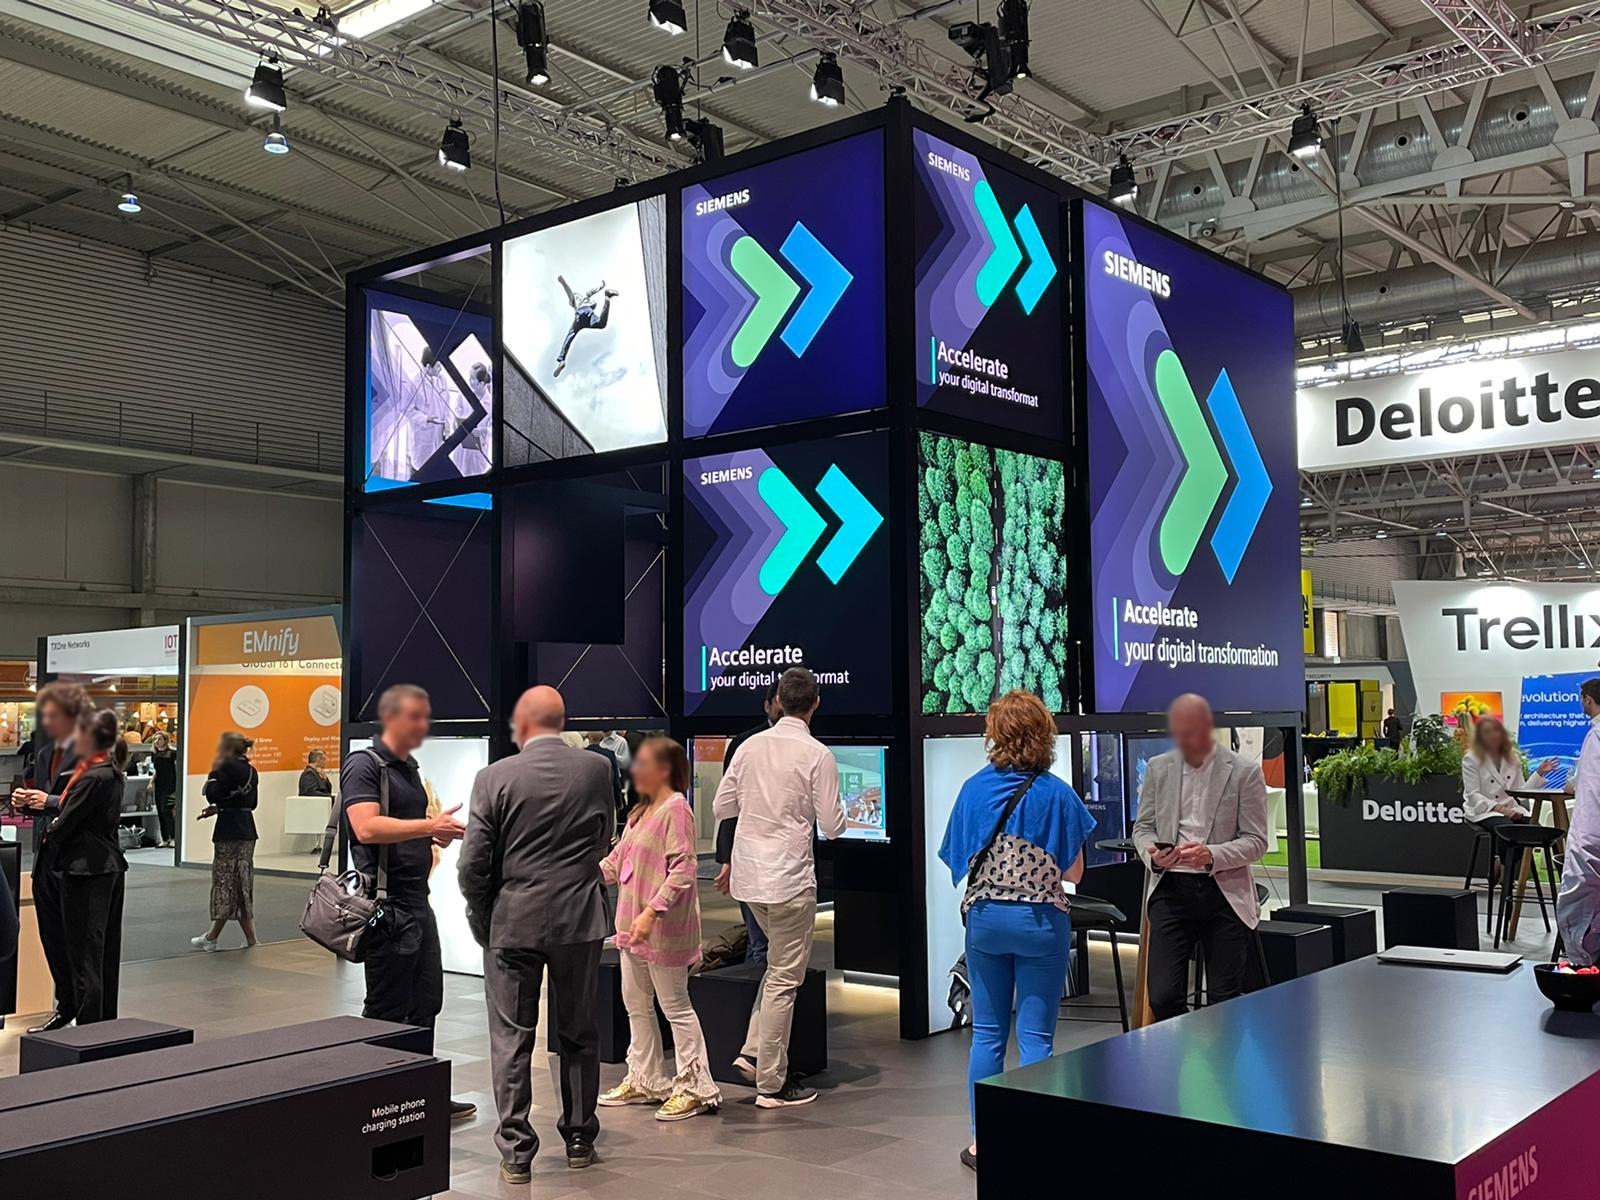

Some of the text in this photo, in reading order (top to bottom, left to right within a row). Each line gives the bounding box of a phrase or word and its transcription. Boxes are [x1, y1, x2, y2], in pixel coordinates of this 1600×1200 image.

[928, 152, 970, 181] SIEMENS
[696, 189, 750, 216] SIEMENS
[1104, 250, 1171, 298] SIEMENS
[937, 341, 1009, 379] Accelerate
[939, 371, 1039, 407] your digital transformat
[1335, 372, 1600, 447] Deloitte
[700, 466, 753, 485] SIEMENS
[1123, 599, 1198, 628] Accelerate
[67, 640, 91, 649] Networks
[243, 627, 300, 657] EMnify
[1124, 637, 1279, 668] your digital transformation
[709, 645, 803, 666] Accelerate
[710, 674, 736, 691] your
[738, 671, 775, 690] digital
[1523, 712, 1568, 720] architecture
[1569, 711, 1585, 720] that
[1527, 719, 1563, 728] delivering
[1563, 719, 1586, 728] higher
[1362, 799, 1464, 824] Deloitte
[371, 1098, 426, 1118] Mobile phone
[361, 1111, 426, 1133] charging station
